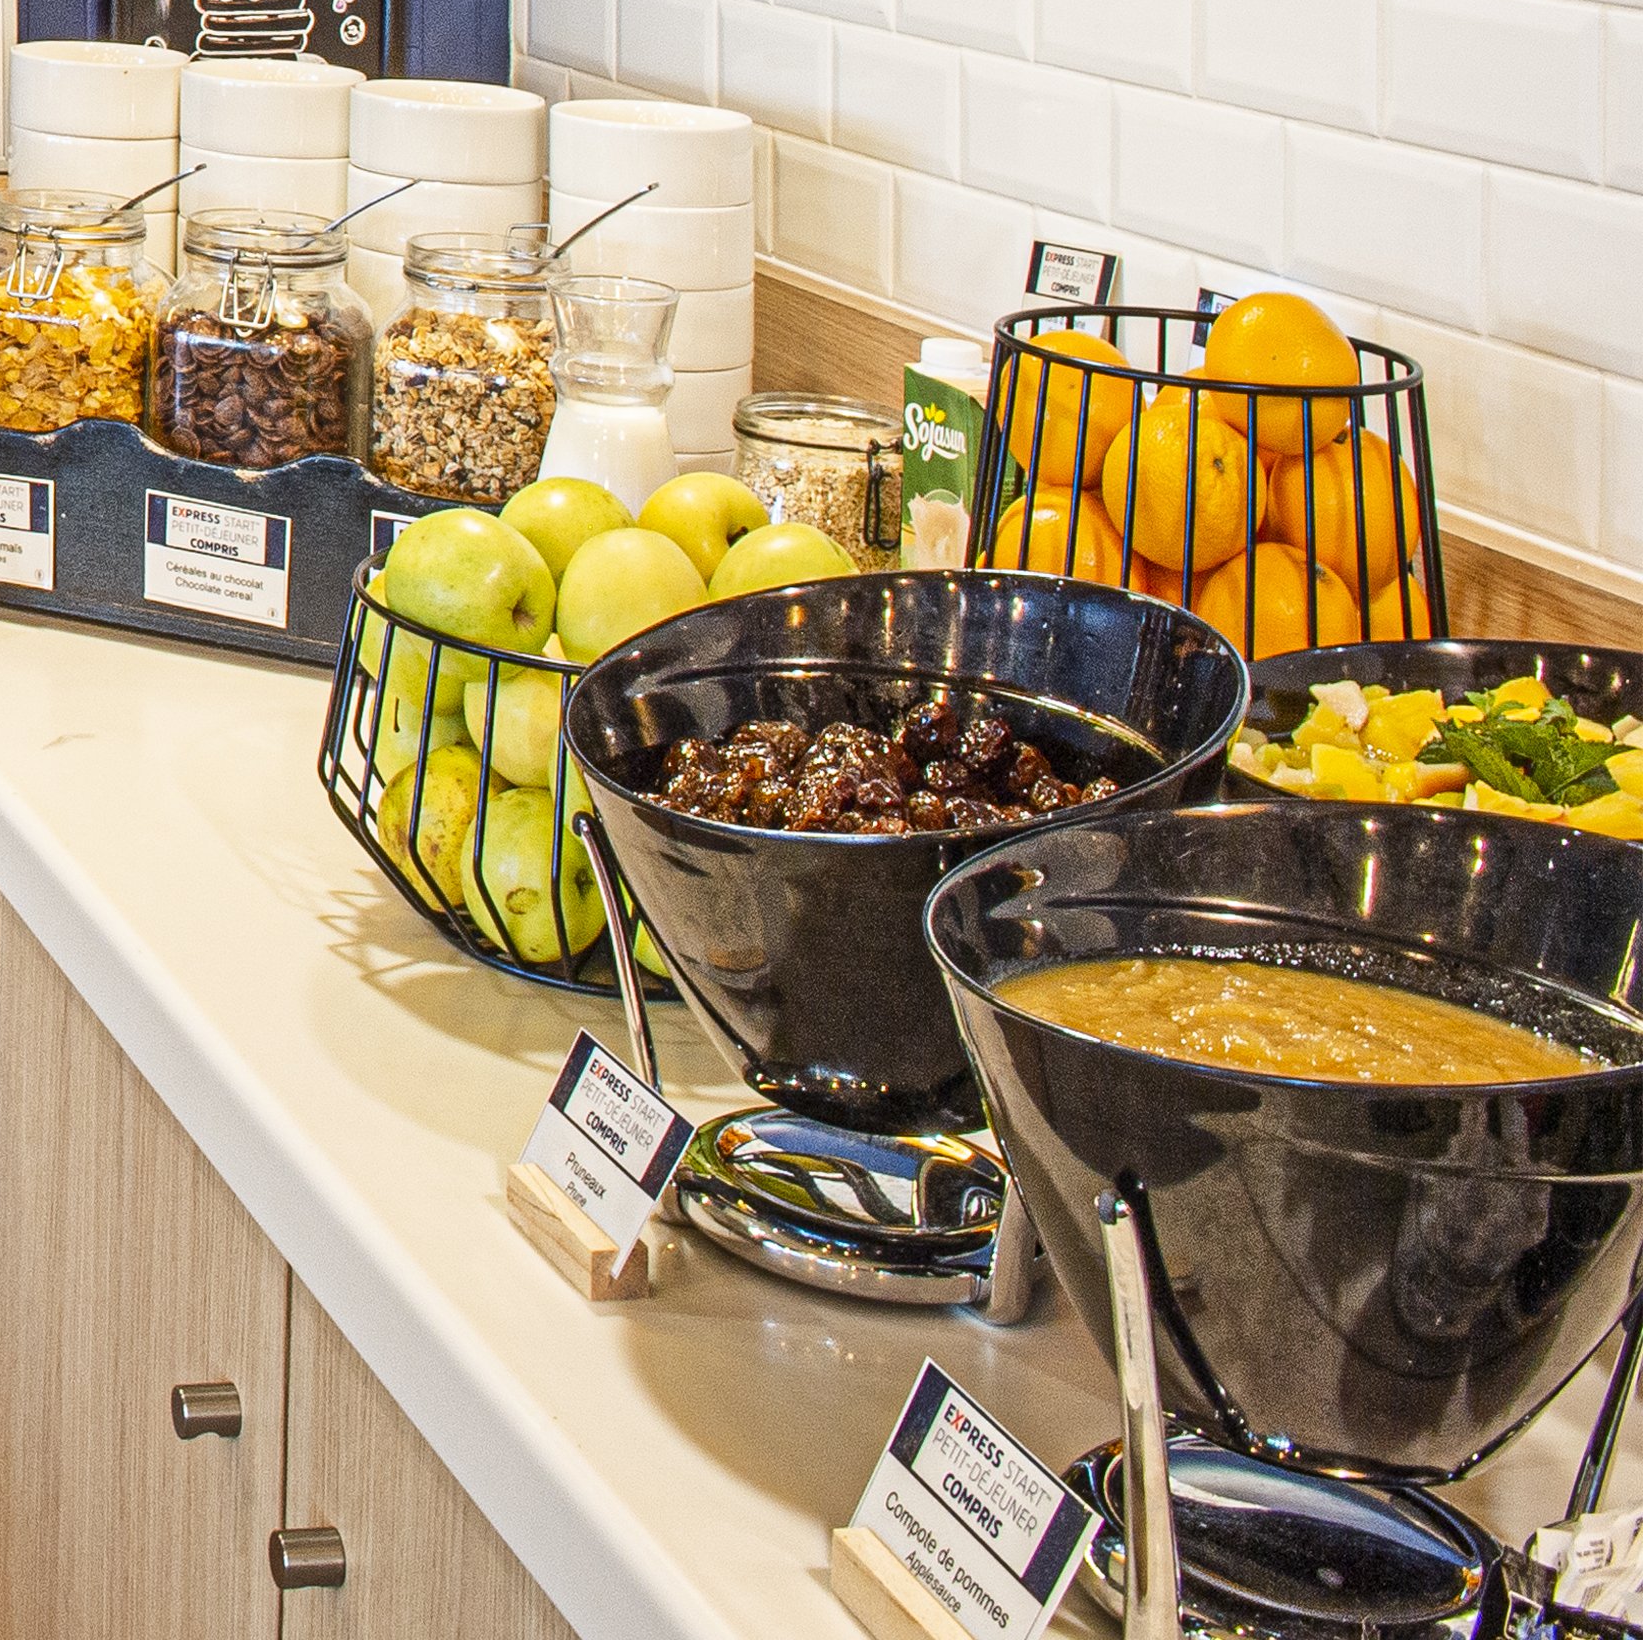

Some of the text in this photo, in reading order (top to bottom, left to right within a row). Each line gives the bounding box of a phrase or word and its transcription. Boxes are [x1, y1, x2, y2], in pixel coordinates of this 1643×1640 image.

[903, 402, 967, 462] Sojasun
[171, 506, 221, 525] EXPRESS
[171, 519, 259, 546] PETIT-DÉJEUNER
[190, 537, 239, 557] COMPRIS
[165, 561, 264, 590] Céréales au chocolat
[175, 576, 253, 601] Chocolate cereal
[589, 1059, 632, 1103] EXPRESS
[579, 1077, 655, 1151] PETIT-DÉJEUNER
[585, 1111, 629, 1157] COMPRIS
[564, 1181, 588, 1208] Prune
[565, 1151, 608, 1200] Pruneaux
[943, 1403, 1005, 1469] EXPRESS
[932, 1427, 1038, 1538] PETIT-DÉJEUNER
[942, 1472, 1004, 1540] COMPRIS
[885, 1491, 1010, 1630] Compote de pommes
[905, 1550, 962, 1615] Applesauce
